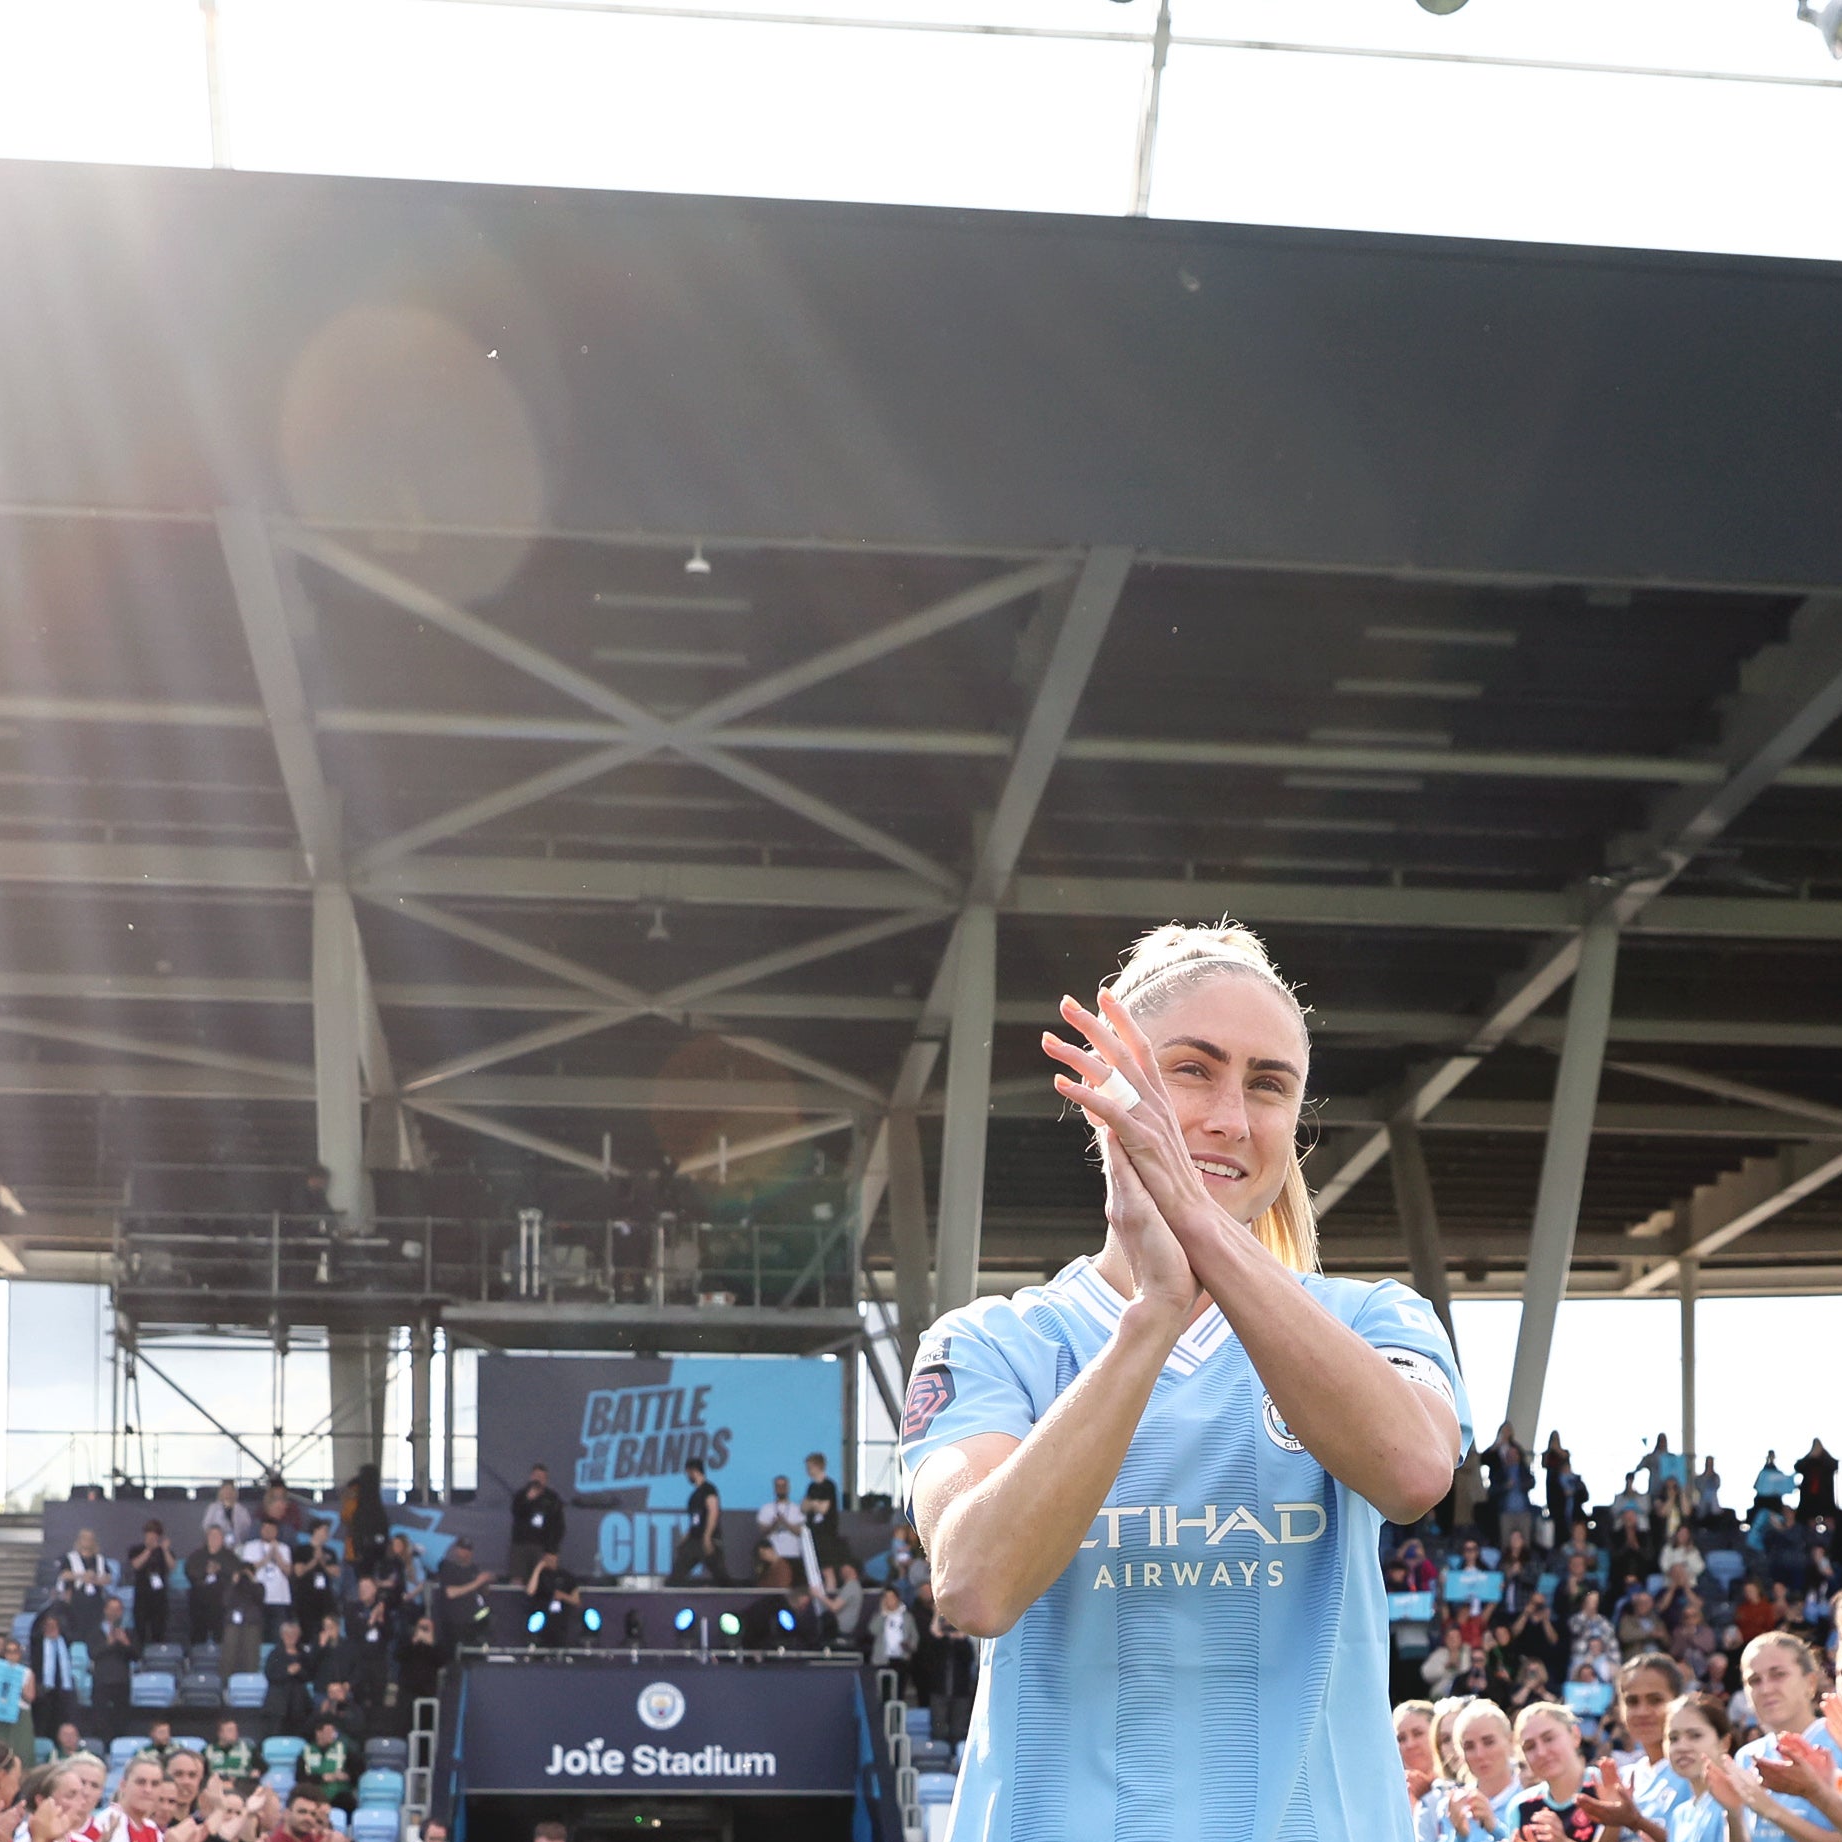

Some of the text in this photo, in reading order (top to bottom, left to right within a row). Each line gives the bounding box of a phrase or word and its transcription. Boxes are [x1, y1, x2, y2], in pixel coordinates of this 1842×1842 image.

[587, 1385, 712, 1438] BATTLE
[613, 1427, 733, 1482] BANDS
[599, 1511, 692, 1576] CIT
[1093, 1560, 1285, 1590] AIRWAYS
[545, 1737, 777, 1777] Joie Stadium
